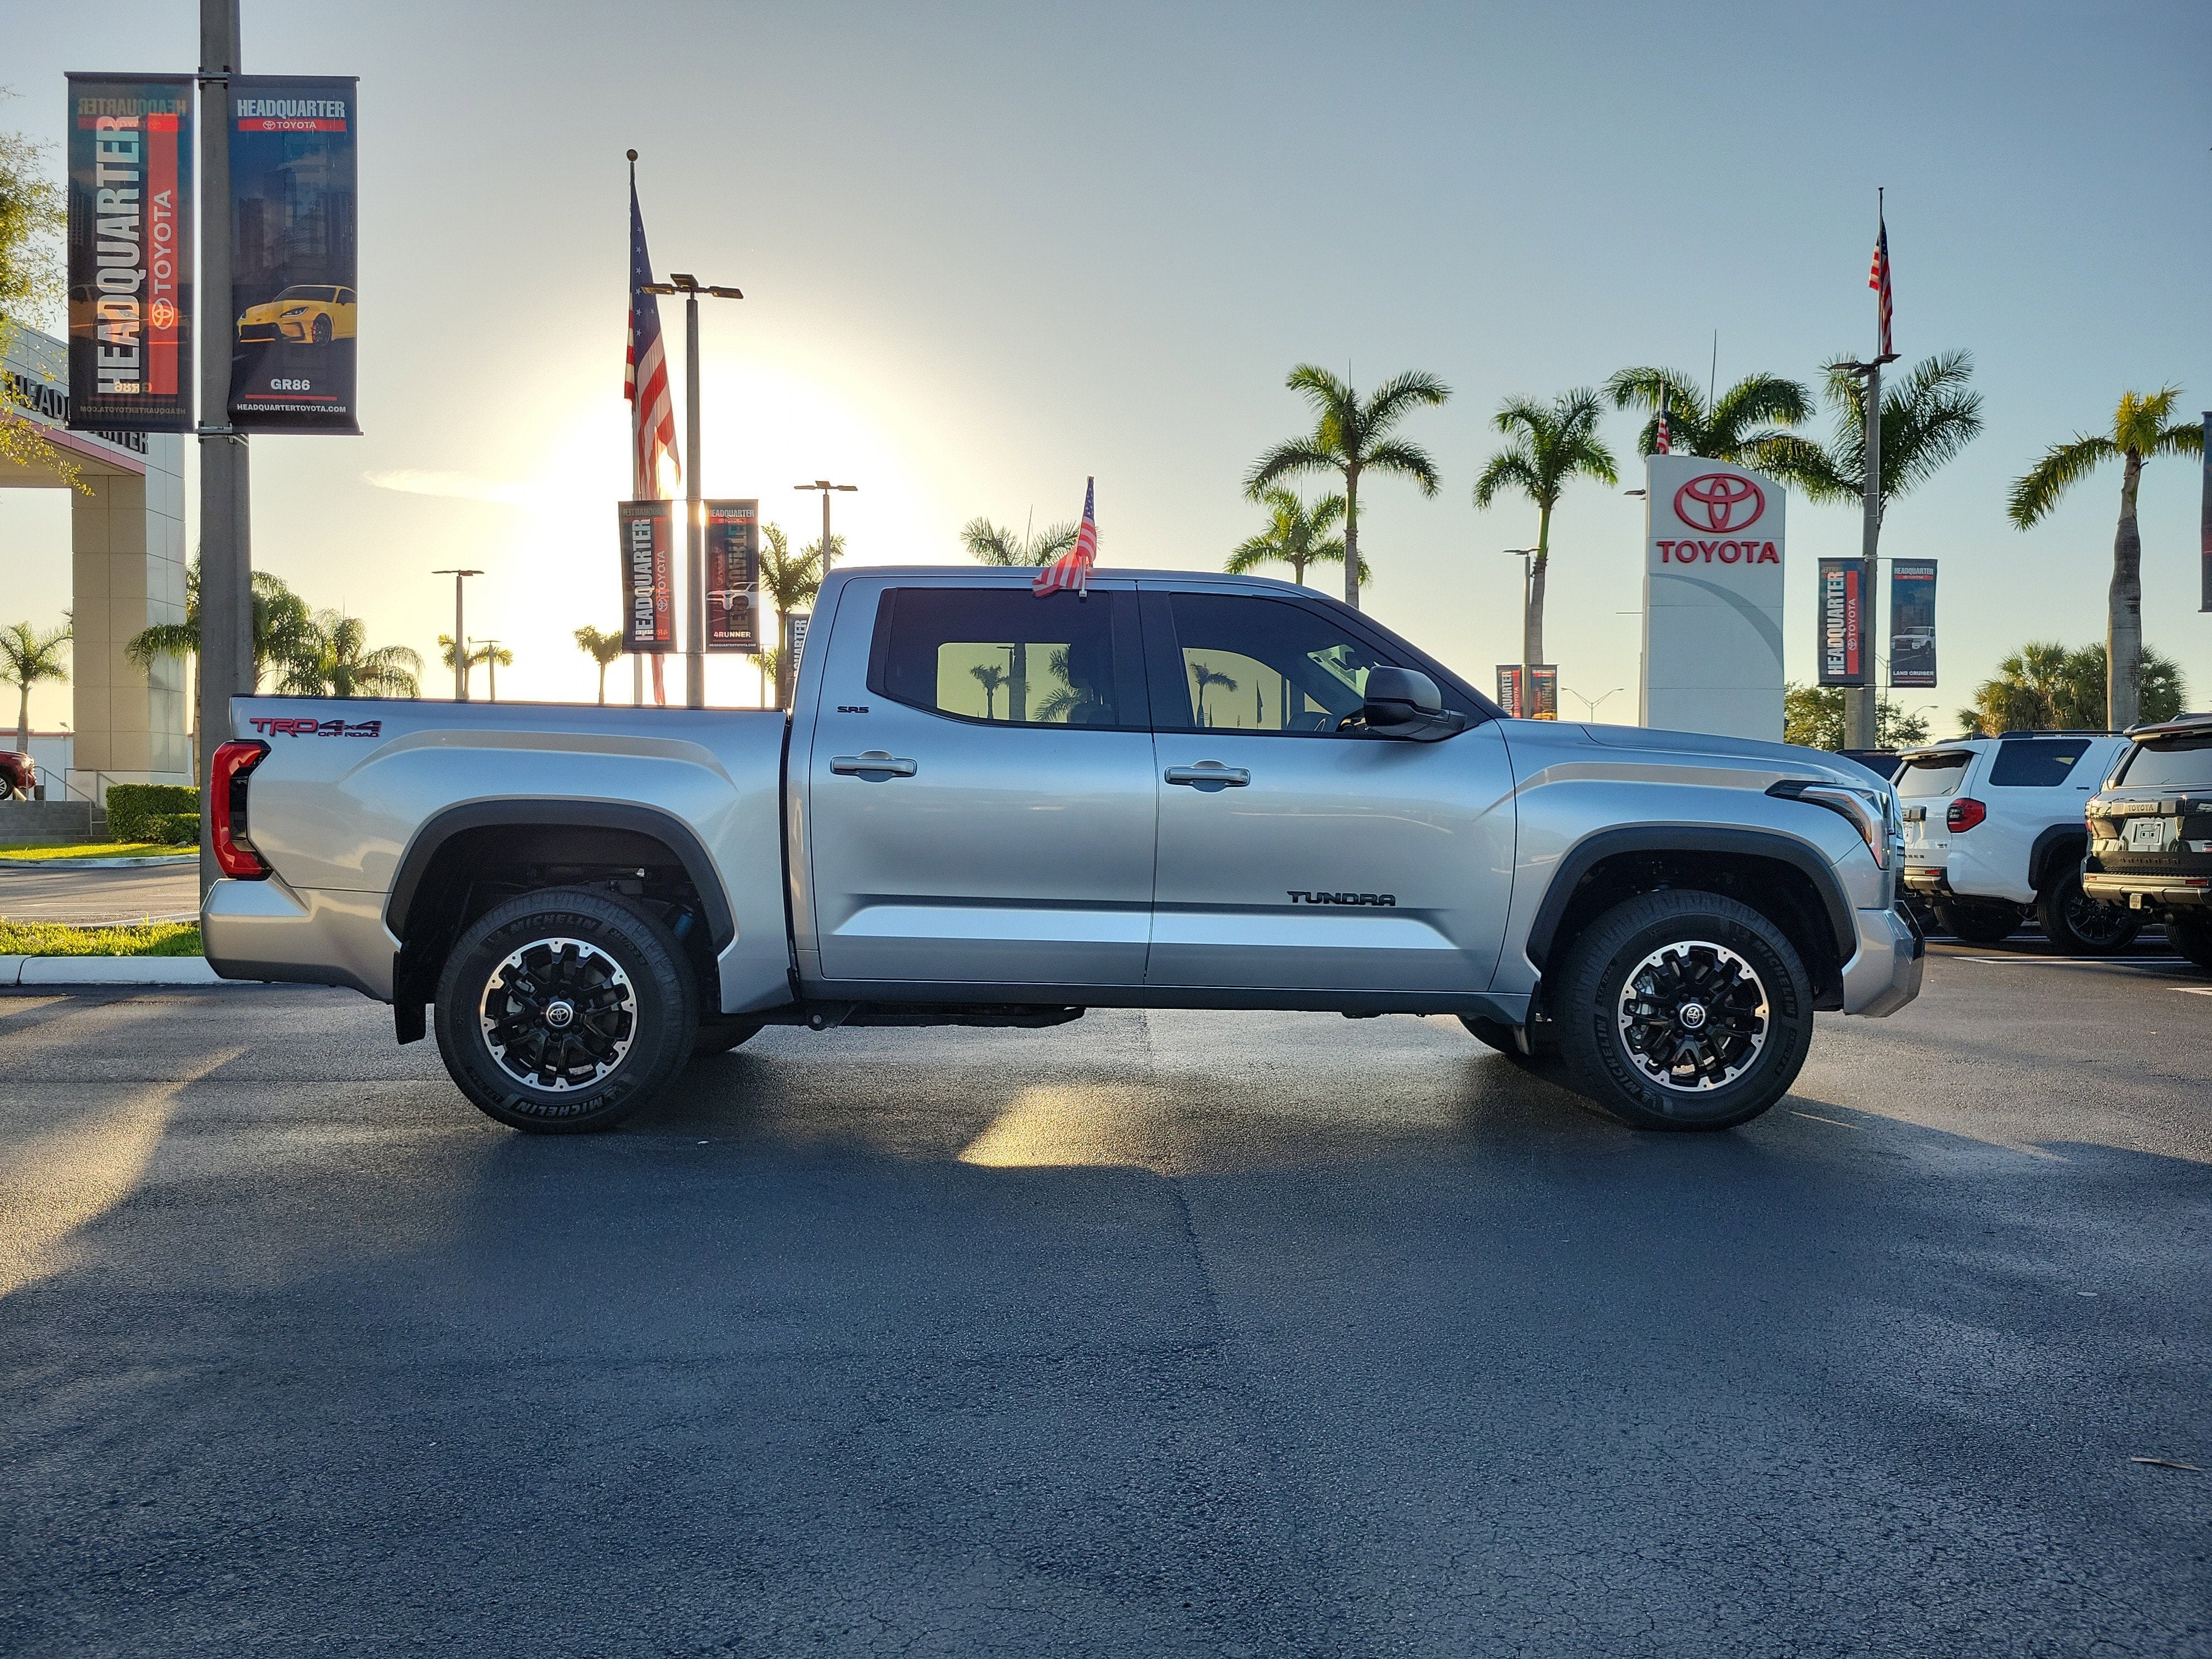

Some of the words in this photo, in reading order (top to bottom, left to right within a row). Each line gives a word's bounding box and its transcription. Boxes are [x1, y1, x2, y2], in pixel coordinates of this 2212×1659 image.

[237, 99, 346, 119] HEADQUARTER
[154, 189, 172, 295] TOYOTA
[96, 116, 147, 394] HEADQUARTER
[270, 378, 311, 391] GR86
[237, 404, 346, 413] HEADQUARTERTOYOTA.COM
[1656, 540, 1780, 563] TOYOTA
[632, 518, 655, 641] HEADQUARTER
[657, 550, 666, 596] TOYOTA
[1827, 571, 1846, 675] HEADQUARTER
[250, 718, 319, 738] TRD
[1286, 891, 1396, 906] TUNDRA
[510, 915, 597, 933] MICHELIN
[1596, 1019, 1641, 1093] MICHELIN
[516, 1097, 603, 1115] MICHELIN
